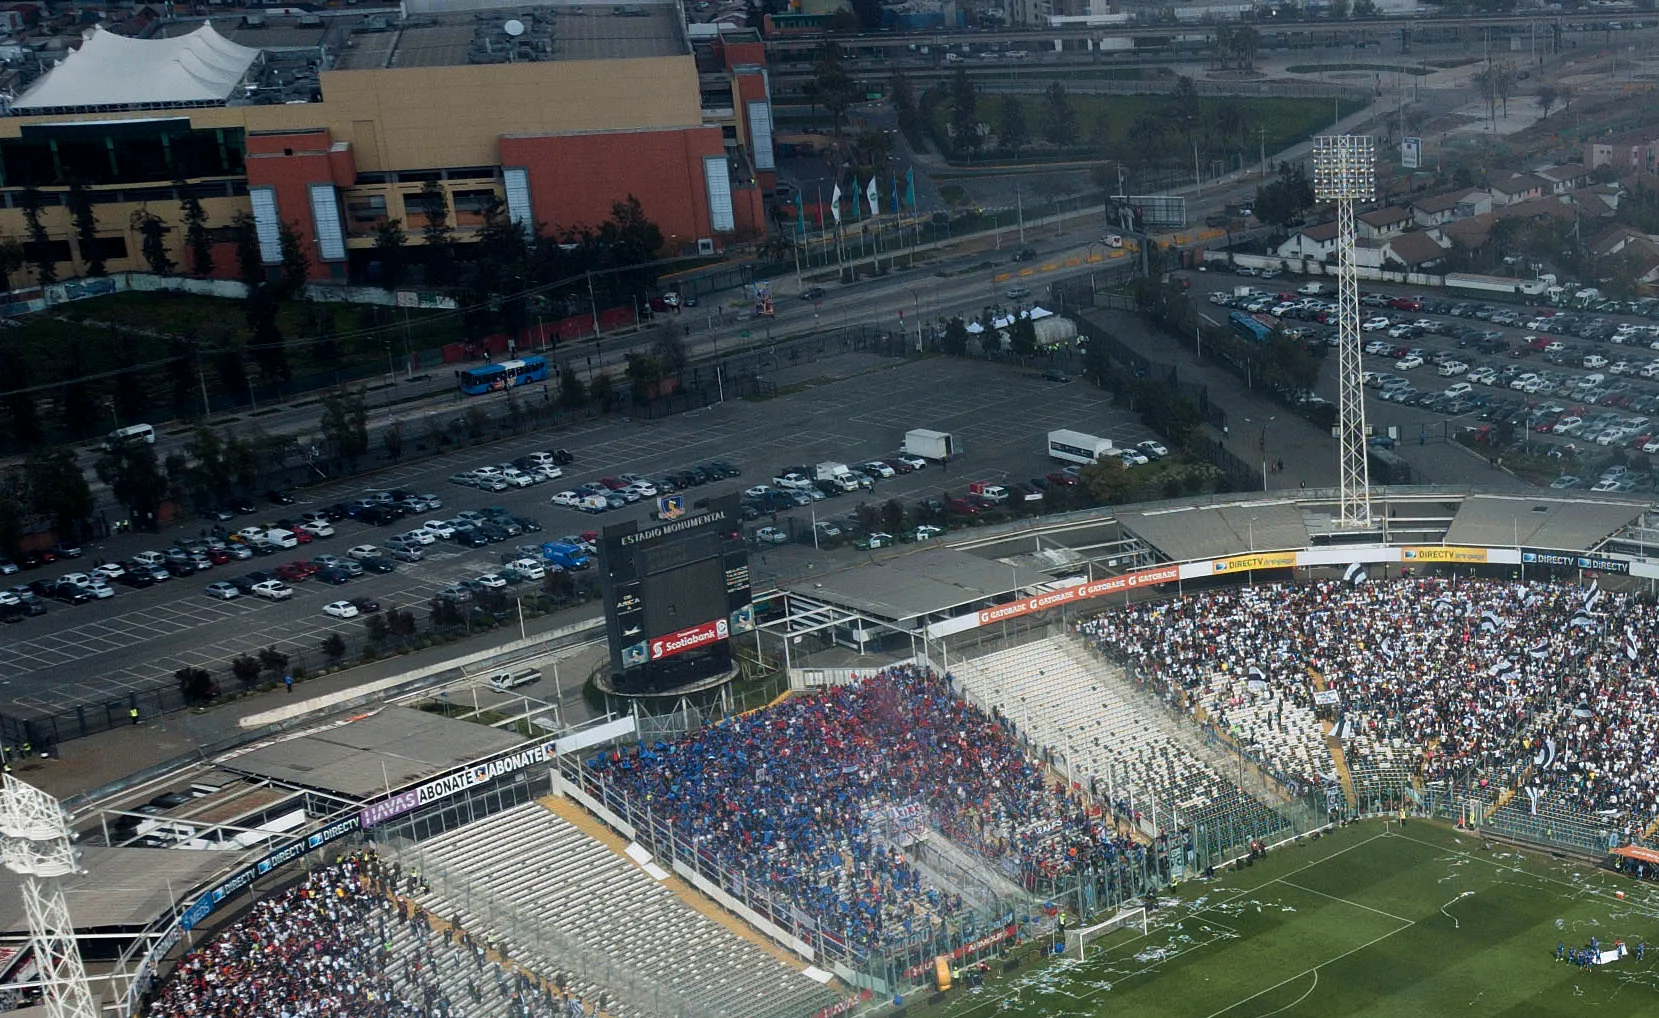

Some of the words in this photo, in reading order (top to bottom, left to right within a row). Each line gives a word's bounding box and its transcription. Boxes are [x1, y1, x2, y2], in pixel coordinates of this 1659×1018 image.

[621, 528, 661, 546] ESTADIO
[663, 511, 726, 534] MONUMENTAL
[1228, 557, 1264, 571] DIRECTV
[1419, 550, 1455, 560] DIRECTV
[1538, 554, 1574, 566] DIRECTV
[1592, 560, 1628, 572] DIRECTV
[990, 603, 1027, 619] GATORADE
[1038, 591, 1074, 606] GATORADE
[1088, 579, 1126, 594] GATORADE
[1138, 570, 1177, 584] GATORADE
[665, 629, 715, 652] Scotiabank
[487, 747, 543, 779] ABONATE
[419, 771, 473, 804] ABONATE
[364, 792, 416, 824] HAVAS
[323, 816, 360, 842] DIRECTV
[271, 841, 305, 867] DIRECTV
[224, 868, 256, 895] DIRECTV
